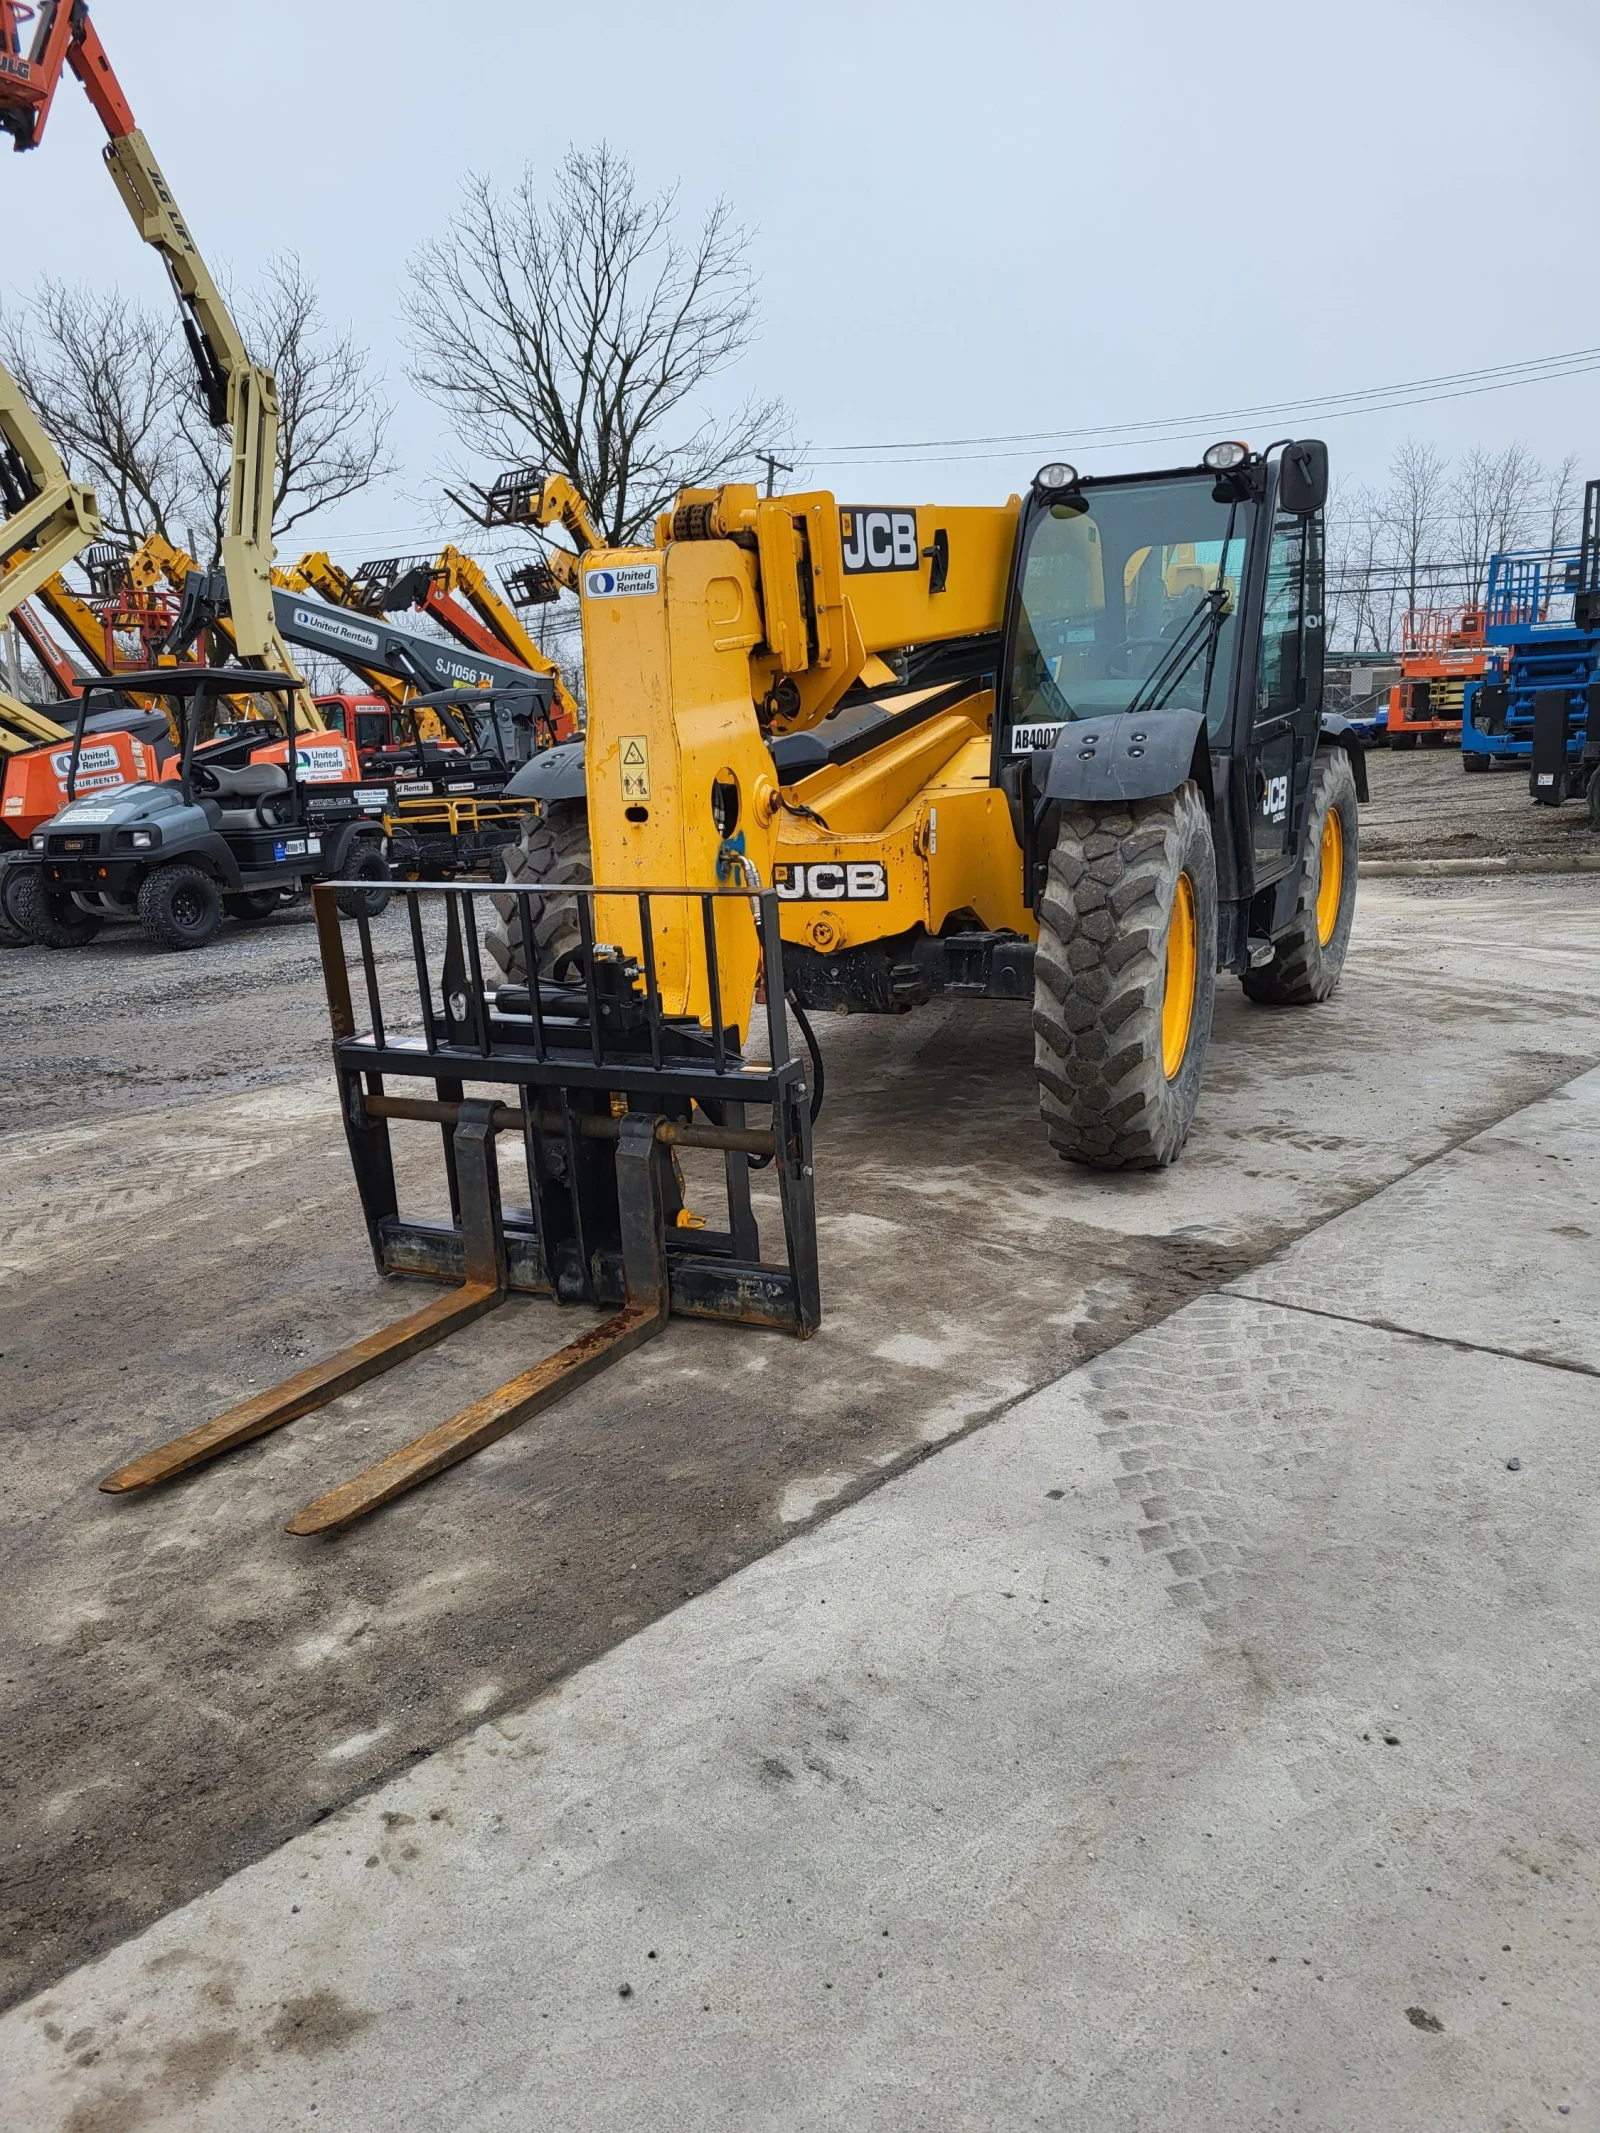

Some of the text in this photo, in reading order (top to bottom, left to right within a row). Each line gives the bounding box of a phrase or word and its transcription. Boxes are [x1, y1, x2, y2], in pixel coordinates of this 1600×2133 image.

[146, 166, 196, 255] JLG LIFT
[843, 512, 917, 569] JCB
[616, 569, 652, 582] United
[616, 581, 655, 593] Rentals
[25, 610, 59, 661] United Rentals
[309, 616, 373, 646] United Rentals
[435, 658, 477, 684] SJ1056
[80, 749, 110, 761] United
[311, 749, 338, 760] United
[82, 758, 115, 770] Rentals
[313, 759, 343, 769] Rentals
[63, 774, 120, 790] 80-UR-RENTS
[403, 784, 430, 793] Rentals
[1263, 775, 1288, 816] JCB
[775, 864, 886, 899] JCB
